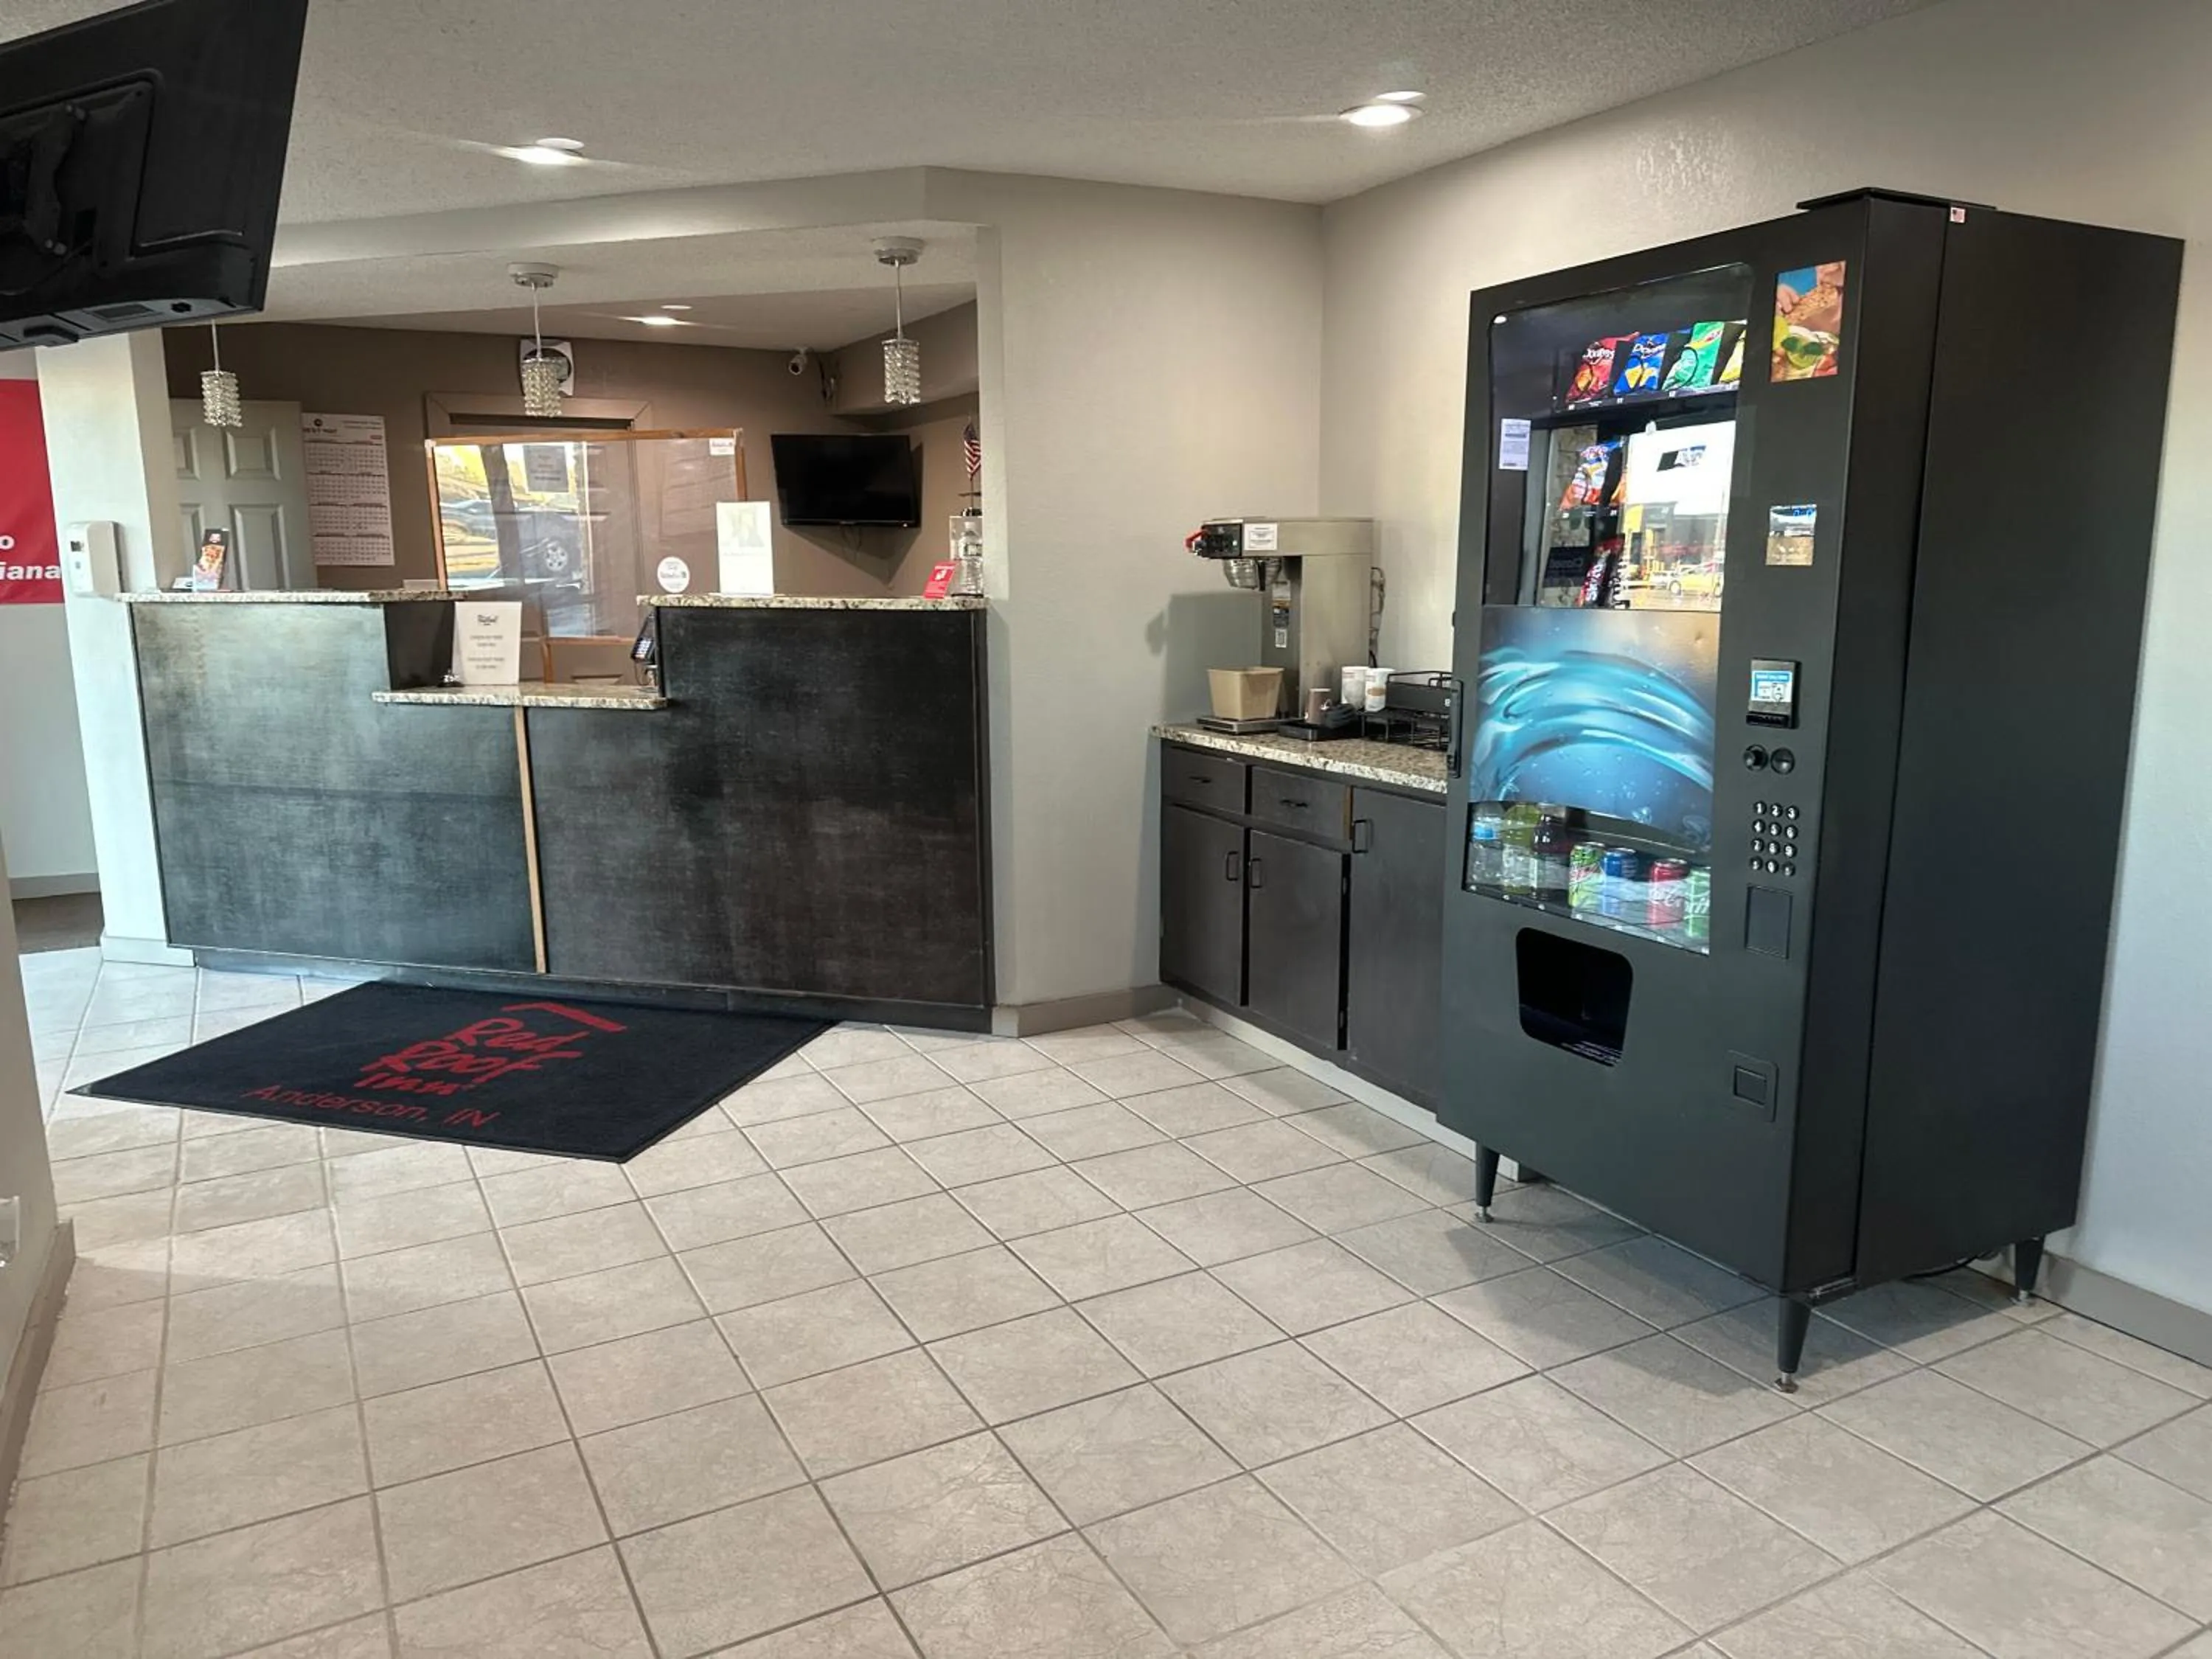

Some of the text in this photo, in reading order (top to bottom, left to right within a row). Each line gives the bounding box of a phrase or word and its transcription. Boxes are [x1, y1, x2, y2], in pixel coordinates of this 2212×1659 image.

[444, 1018, 590, 1052] Red
[360, 1040, 583, 1084] Roof
[443, 1107, 501, 1127] IN
